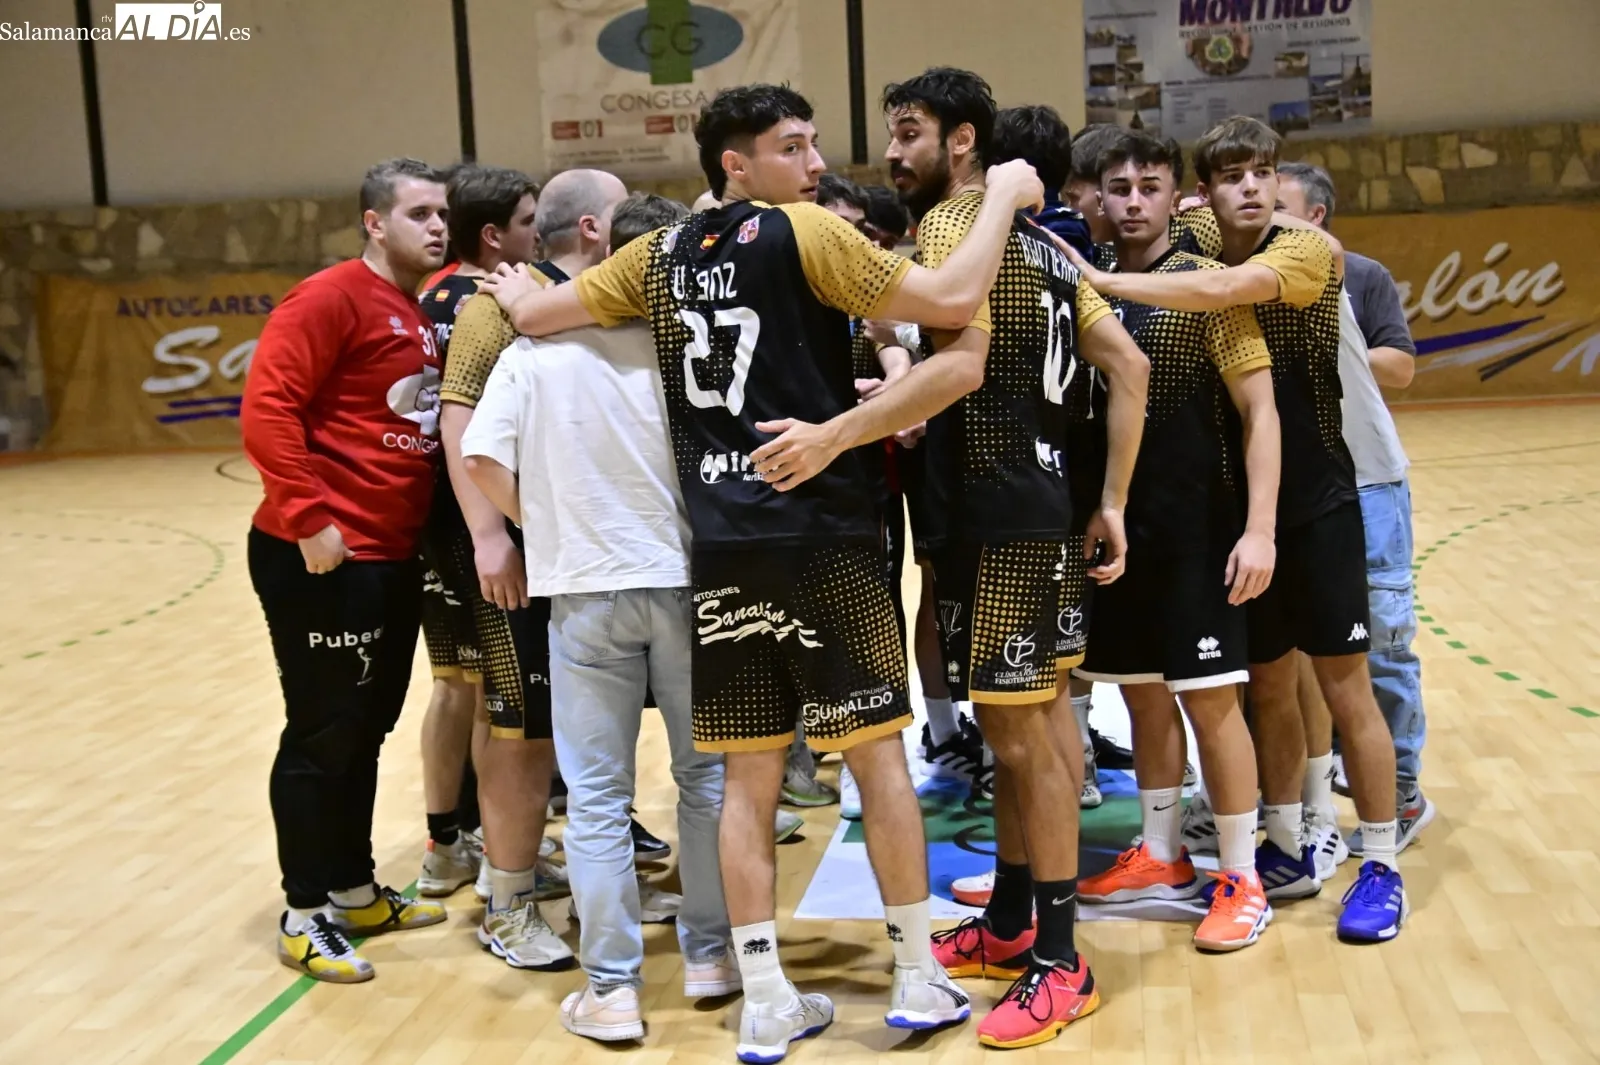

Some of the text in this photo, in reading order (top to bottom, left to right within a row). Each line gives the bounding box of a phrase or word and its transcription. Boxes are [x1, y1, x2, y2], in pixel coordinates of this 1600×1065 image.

[600, 90, 709, 114] CONGESA
[117, 294, 275, 318] AUTOCARES
[418, 325, 437, 358] 31
[674, 306, 760, 416] 27
[308, 626, 384, 649] Pubee
